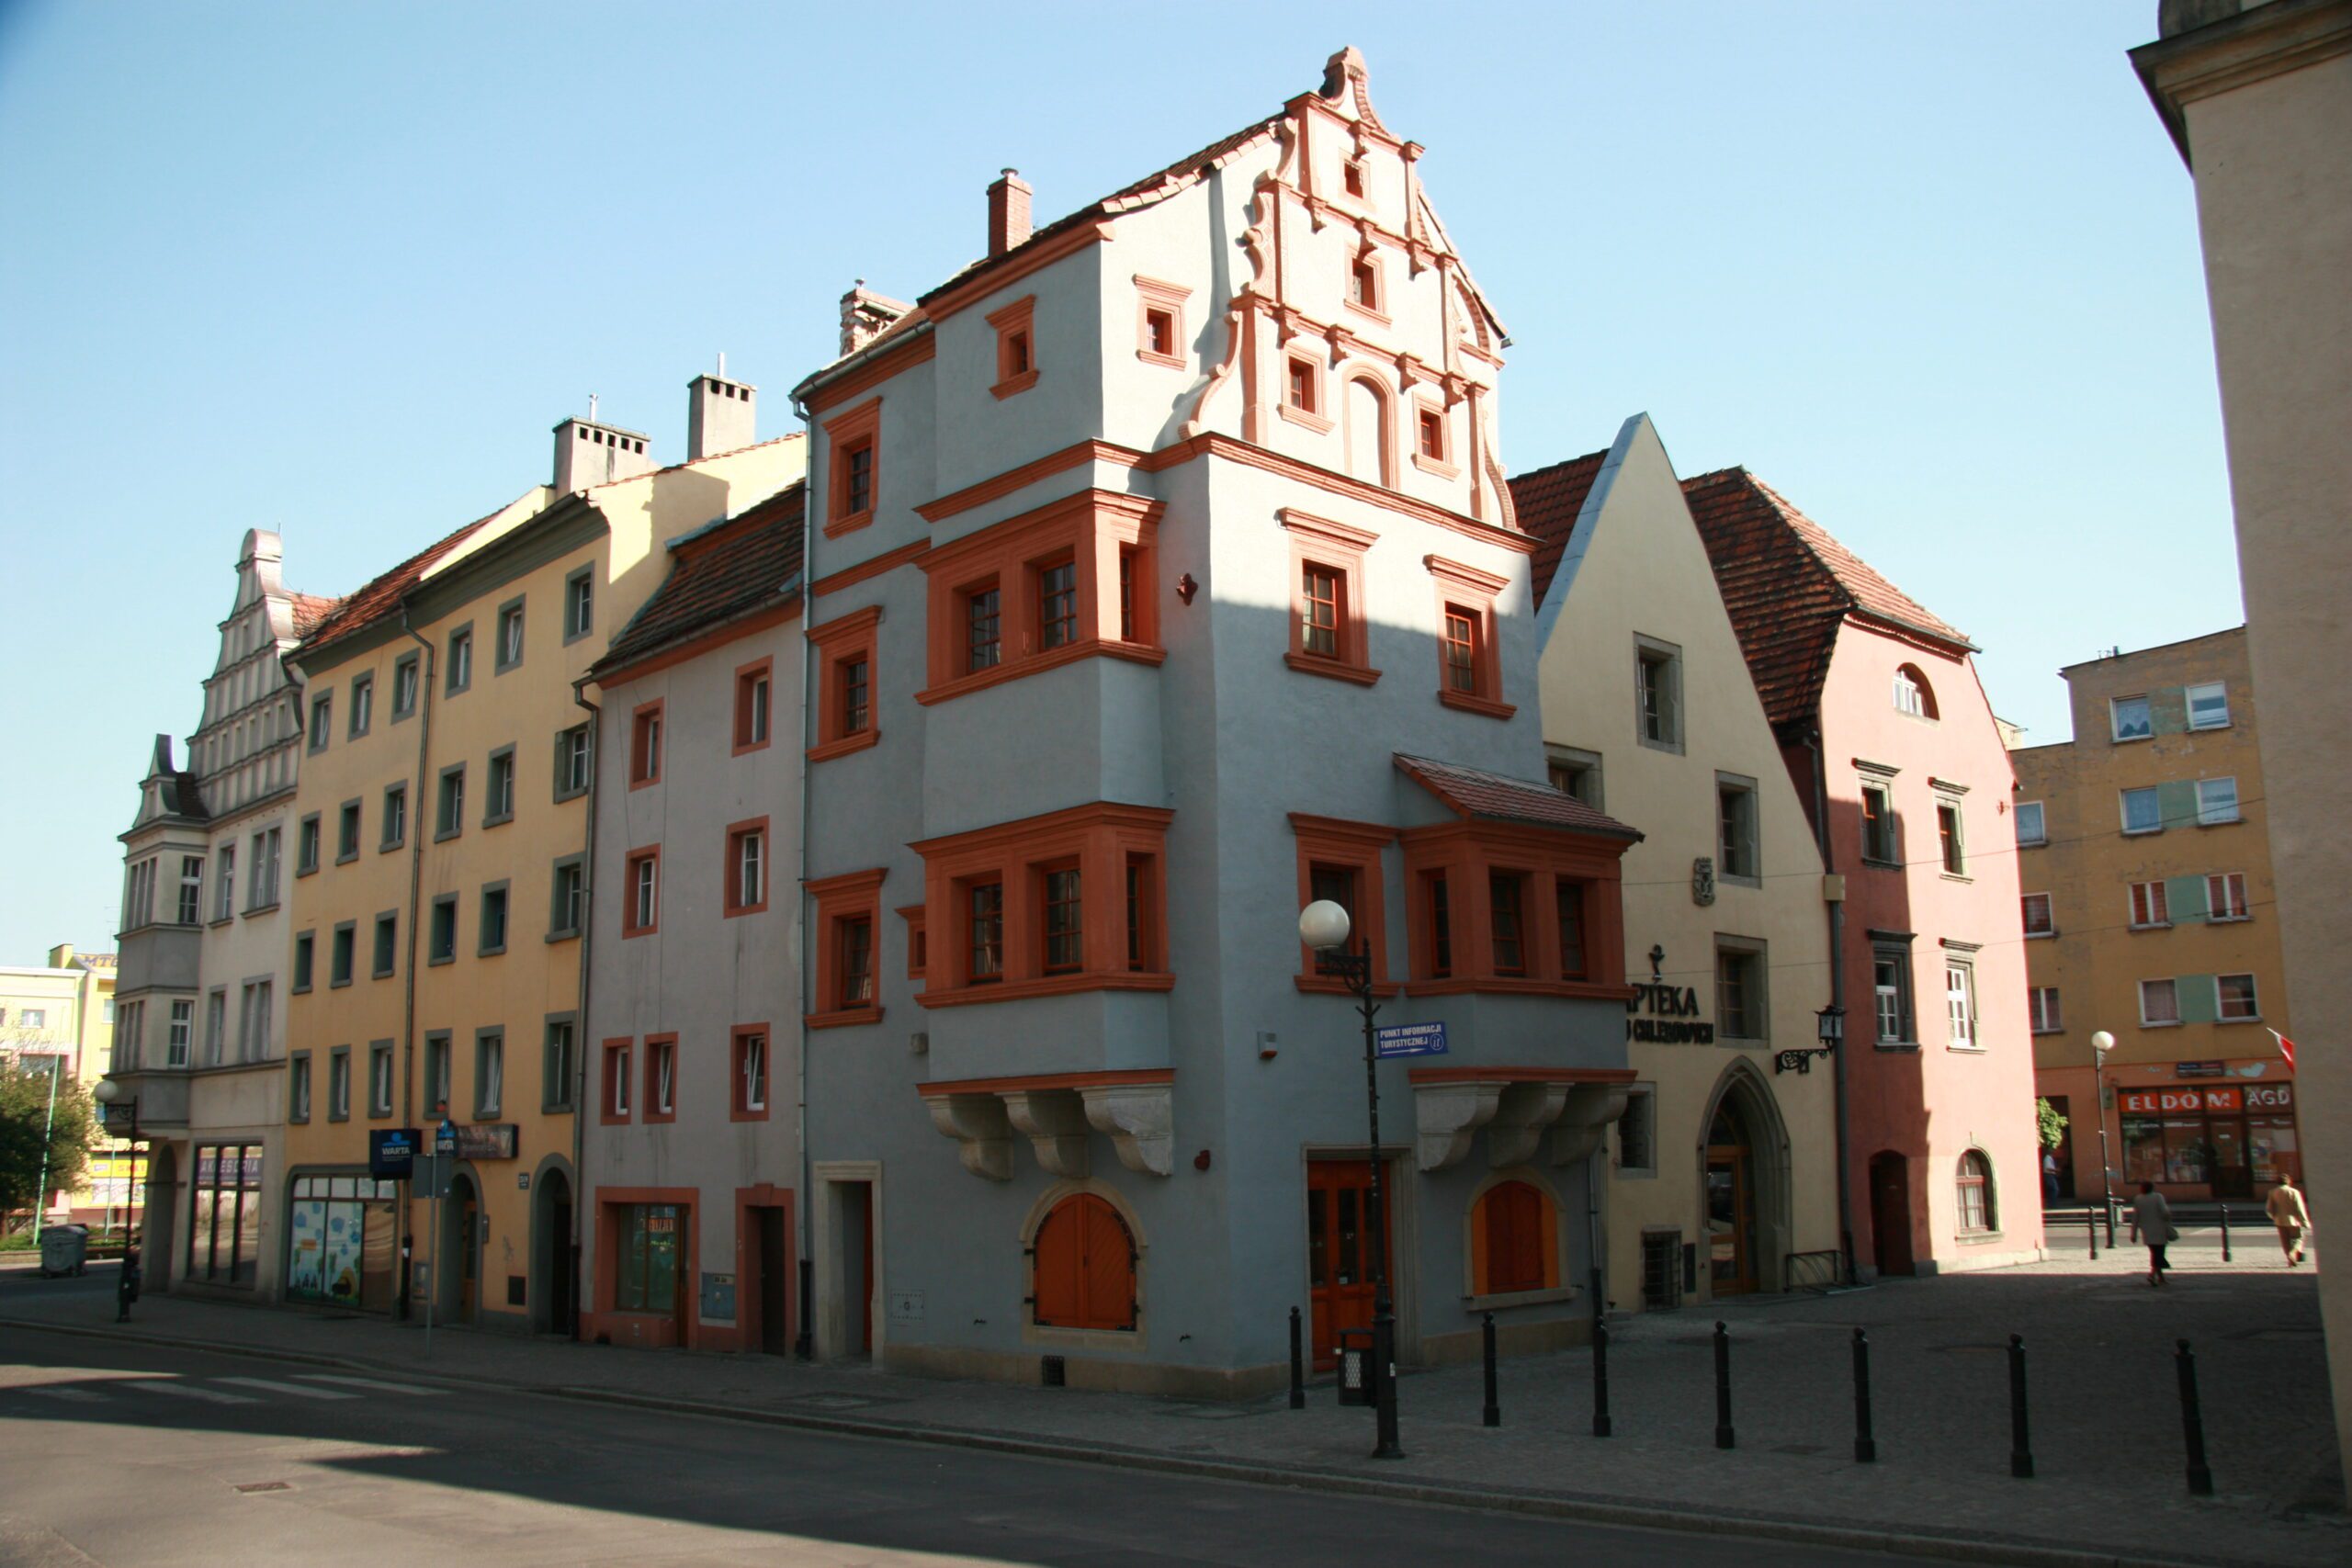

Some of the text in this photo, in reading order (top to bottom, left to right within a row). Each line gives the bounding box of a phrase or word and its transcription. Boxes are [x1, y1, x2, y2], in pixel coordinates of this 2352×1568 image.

[1380, 1024, 1442, 1038] PUNKT INFORMACJI
[1380, 1037, 1428, 1049] TURYSTYCZNEJ
[2128, 1089, 2290, 1111] ELDOM AGD
[382, 1146, 410, 1156] WARTA
